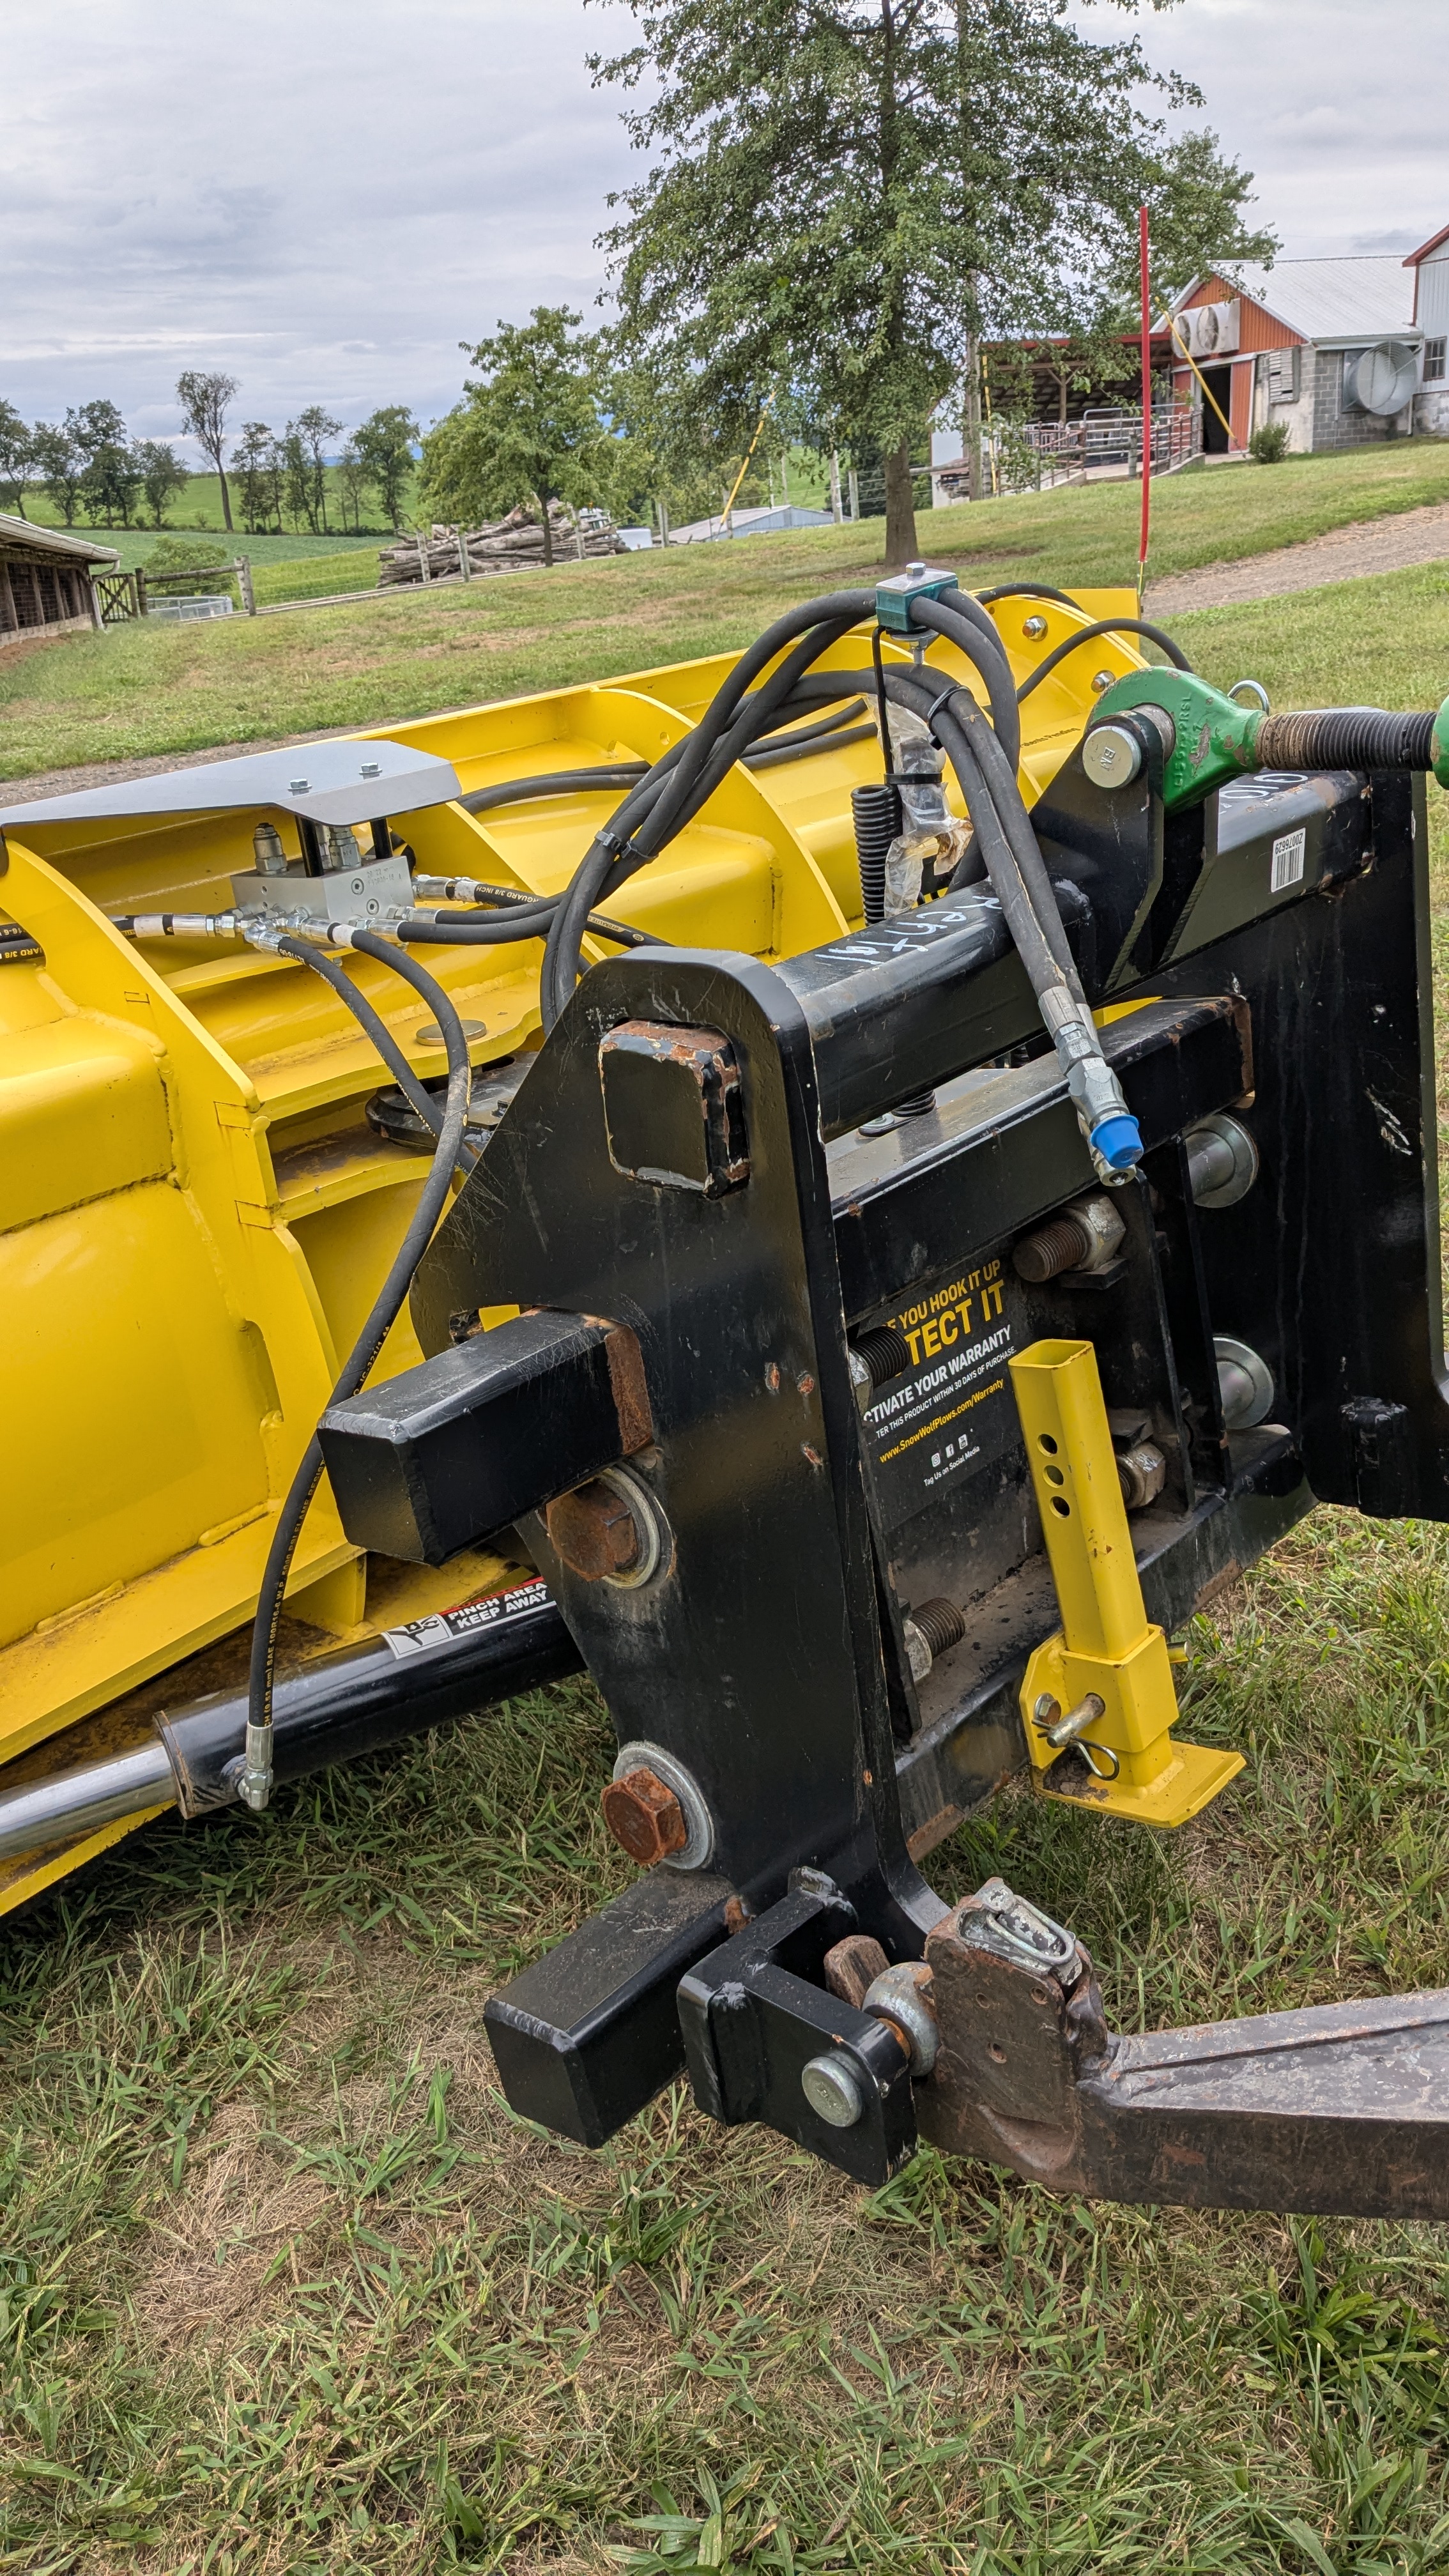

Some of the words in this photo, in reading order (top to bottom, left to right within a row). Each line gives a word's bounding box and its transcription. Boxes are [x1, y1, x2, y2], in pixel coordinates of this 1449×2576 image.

[1275, 832, 1303, 855] Z0076629
[4, 928, 23, 936] 16-6
[899, 1302, 928, 1330] YOU
[930, 1279, 967, 1313] HOOK
[968, 1269, 981, 1291] IT
[983, 1259, 1000, 1281] UP
[904, 1298, 972, 1366] TECT
[981, 1279, 1004, 1321] IT
[915, 1366, 947, 1398] YOUR
[948, 1324, 1011, 1376] WARRANTY
[889, 1416, 904, 1430] THIS
[904, 1397, 932, 1422] PRODUCT
[932, 1384, 954, 1404] WITHIN
[954, 1379, 962, 1391] 30
[962, 1370, 977, 1385] DAYS
[977, 1365, 985, 1376] OF
[986, 1346, 1016, 1370] PURCHASE.
[879, 1378, 1004, 1464] www.SnowWolfPlows.com/Warranty
[924, 1476, 934, 1487] Tag
[934, 1471, 942, 1481] Us
[942, 1468, 949, 1476] on
[949, 1456, 965, 1470] Social
[965, 1446, 980, 1460] Media
[295, 1499, 310, 1533] FLAME
[448, 1597, 500, 1621] PINCH
[504, 1583, 548, 1602] AREA
[456, 1607, 500, 1629] KEEP
[505, 1590, 547, 1613] AWAY
